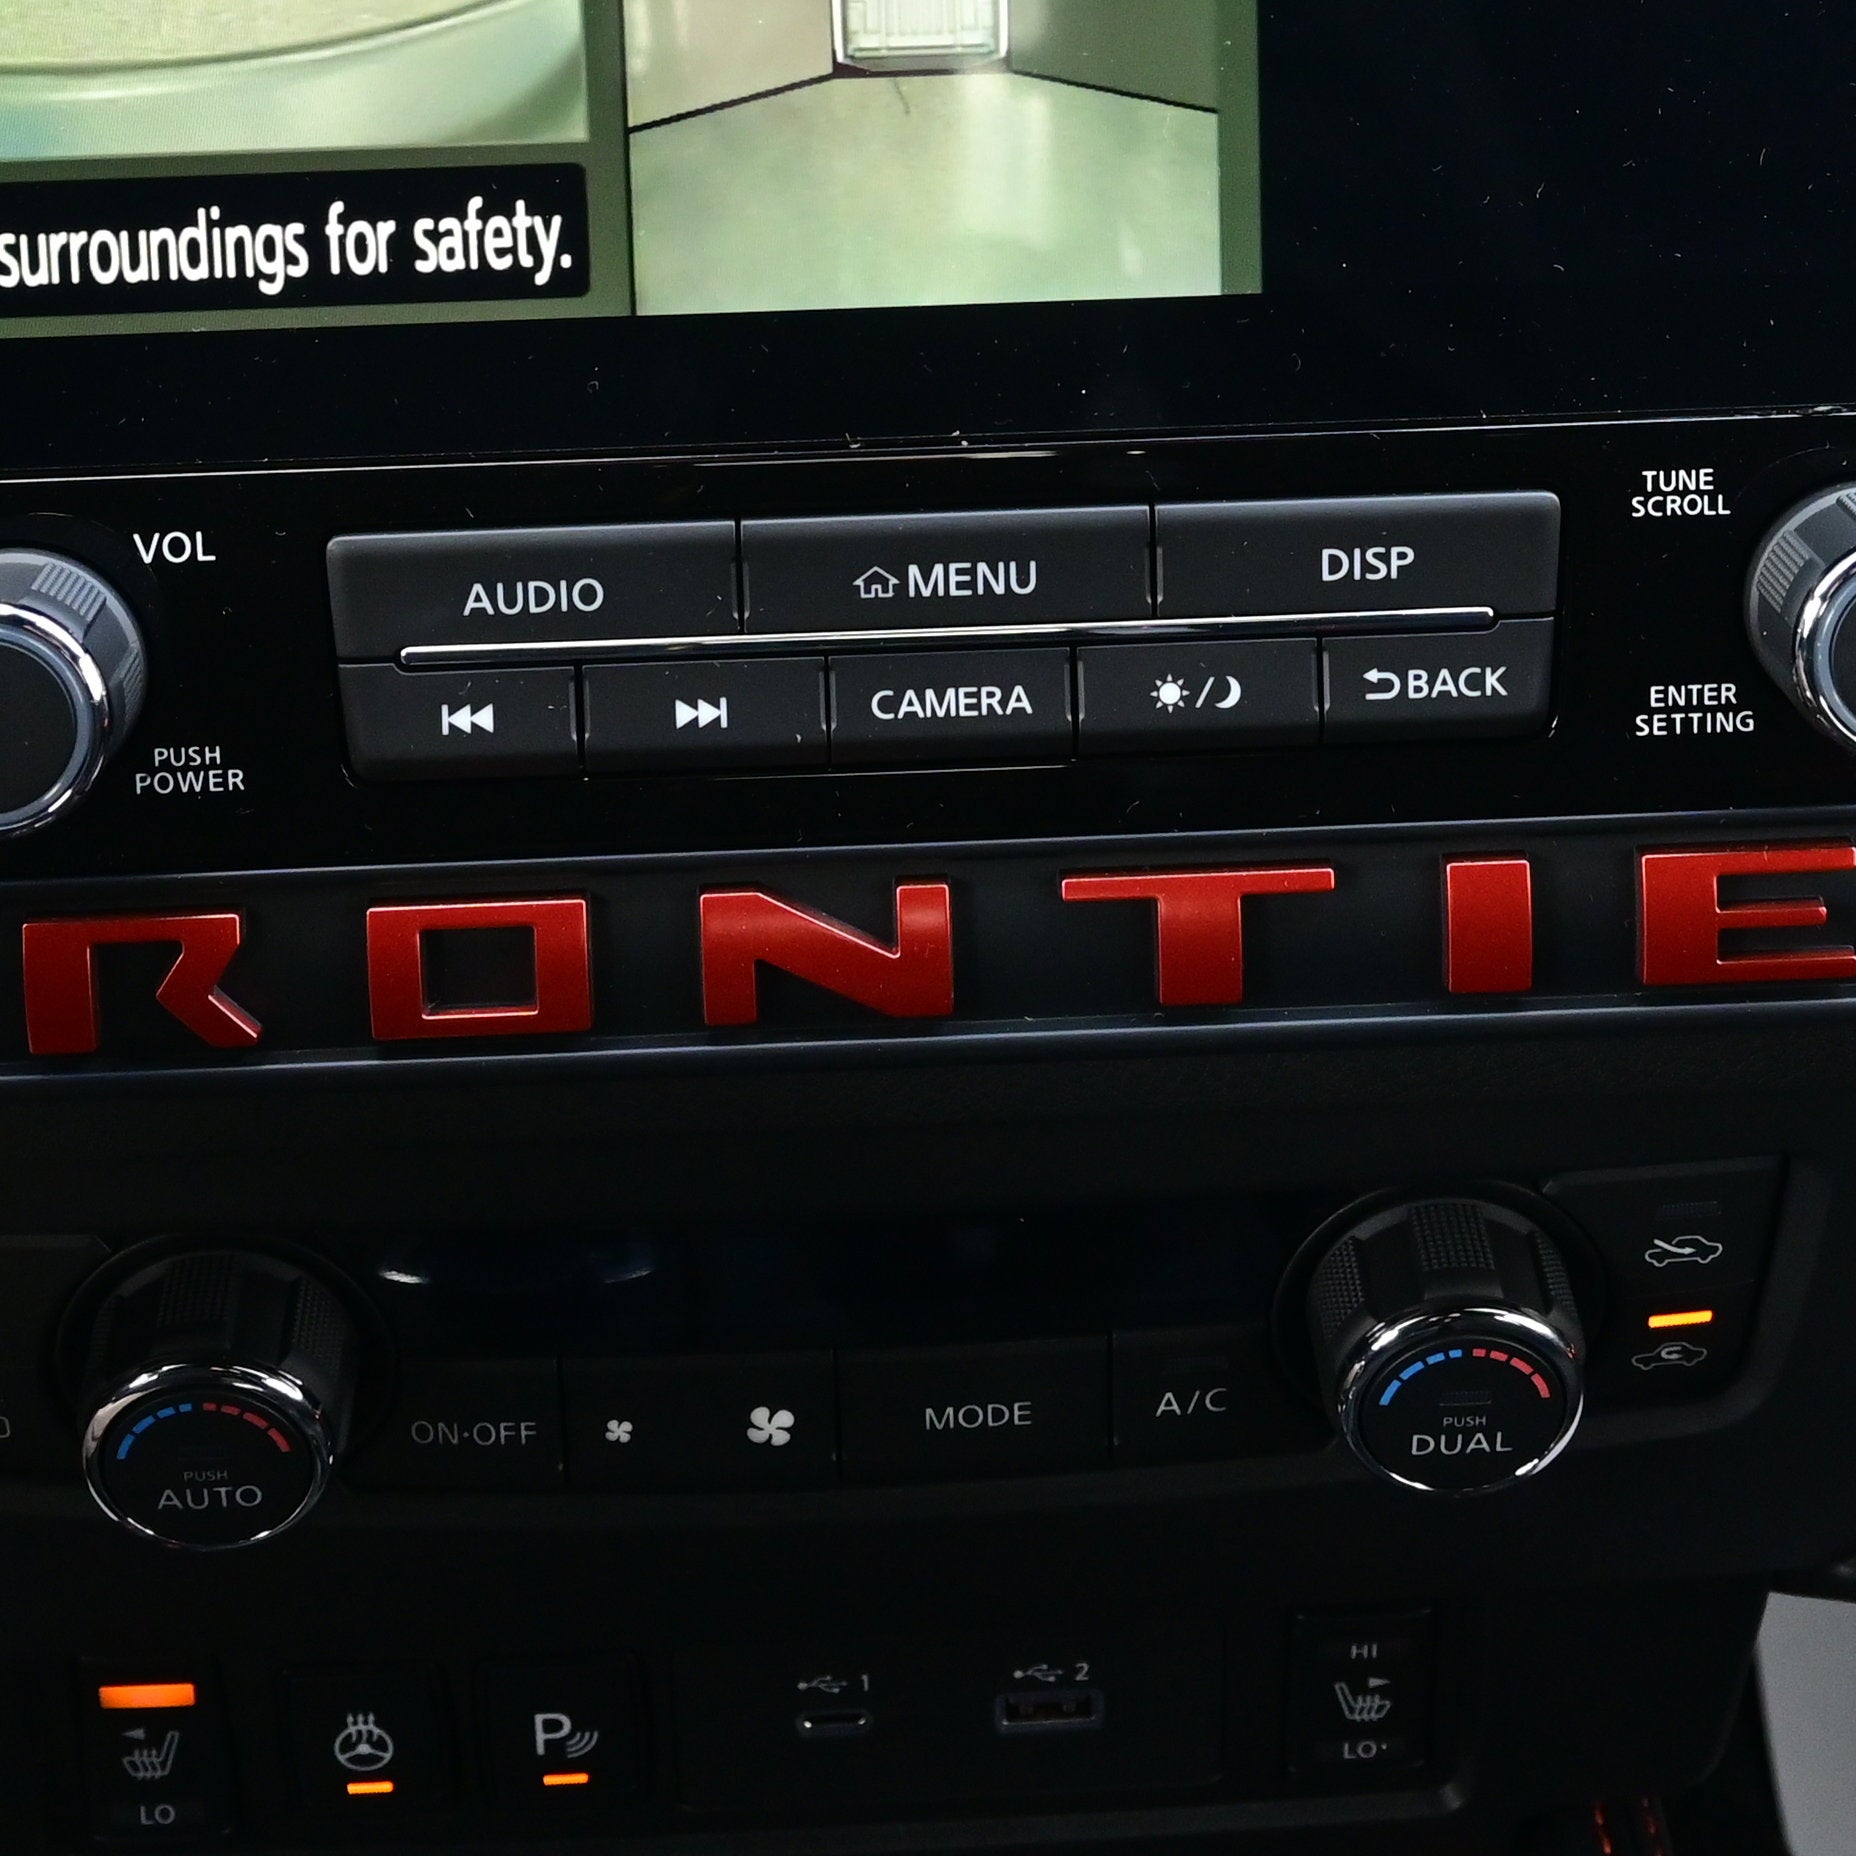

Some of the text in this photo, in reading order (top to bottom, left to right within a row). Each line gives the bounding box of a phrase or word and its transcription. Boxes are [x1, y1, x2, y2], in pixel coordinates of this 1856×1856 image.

[325, 200, 393, 275] for
[413, 197, 573, 287] safety.
[1640, 467, 1715, 495] TUNE
[1630, 490, 1731, 518] SCROLL
[133, 530, 217, 566] VOL
[1320, 546, 1415, 584] DISP
[906, 560, 1039, 600] MENU
[462, 577, 605, 618] AUDIO
[1406, 665, 1508, 700] BACK
[1649, 682, 1738, 710] ENTER
[870, 683, 1034, 722] CAMERA
[1634, 708, 1755, 738] SETTING
[153, 746, 223, 770] PUSH
[134, 768, 246, 796] POWER
[924, 1401, 1033, 1432] MODE
[1156, 1386, 1228, 1419] A/C
[1441, 1413, 1488, 1430] PUSH
[1411, 1429, 1513, 1457] DUAL
[183, 1469, 229, 1482] PUSH
[157, 1484, 263, 1512] AUTO
[1350, 1642, 1379, 1660] HI
[1074, 1663, 1090, 1682] 2
[1343, 1741, 1377, 1760] LO
[140, 1804, 176, 1826] LO
